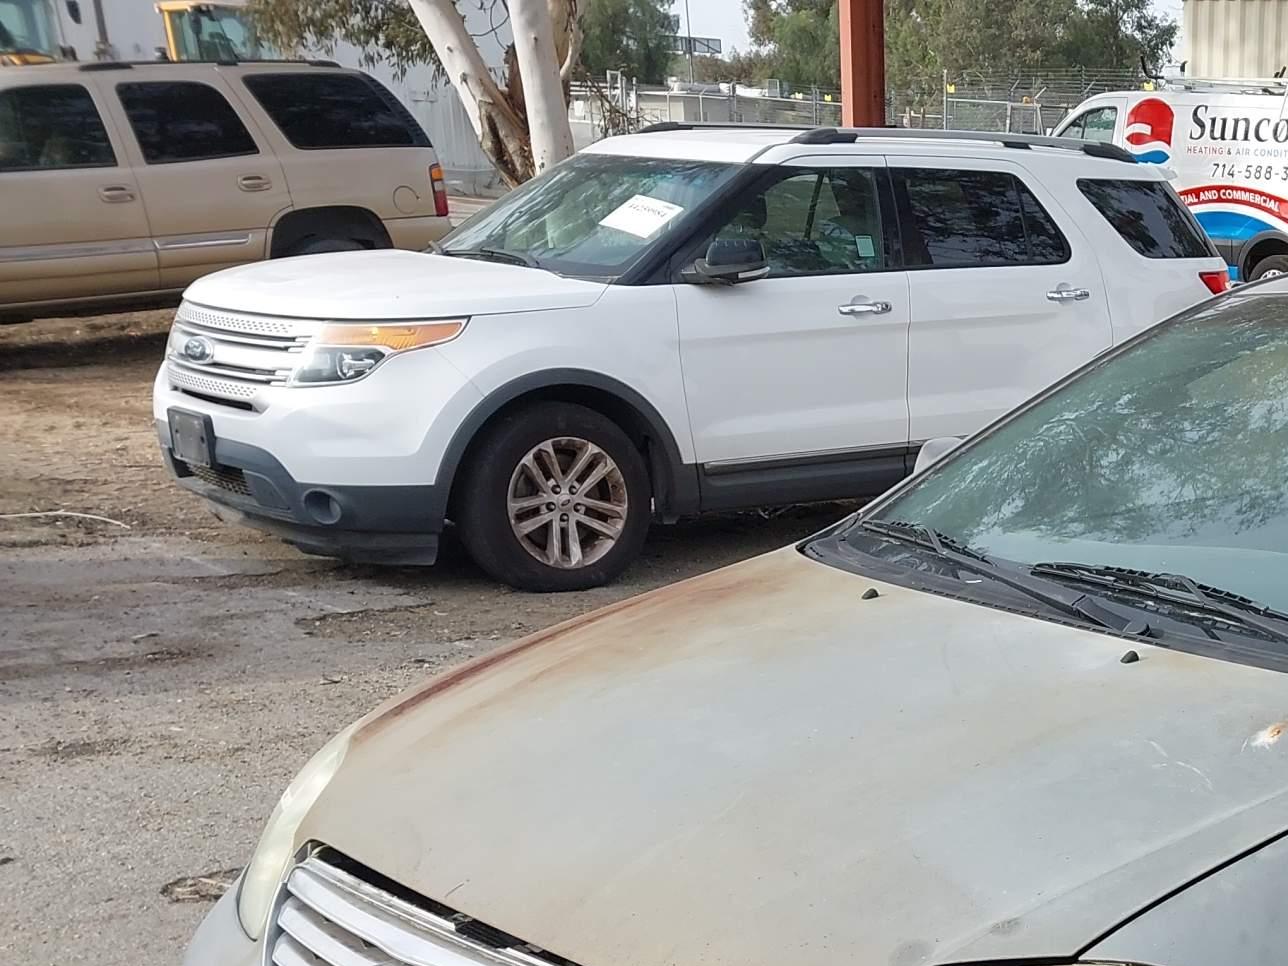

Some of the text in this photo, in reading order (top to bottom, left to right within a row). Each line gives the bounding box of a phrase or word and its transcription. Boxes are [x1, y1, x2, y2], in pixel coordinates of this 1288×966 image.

[1187, 146, 1224, 155] HEATING
[1226, 147, 1232, 155] &
[1235, 147, 1250, 156] AIR
[1200, 190, 1218, 201] AND
[1220, 189, 1280, 212] COMMERCIAL
